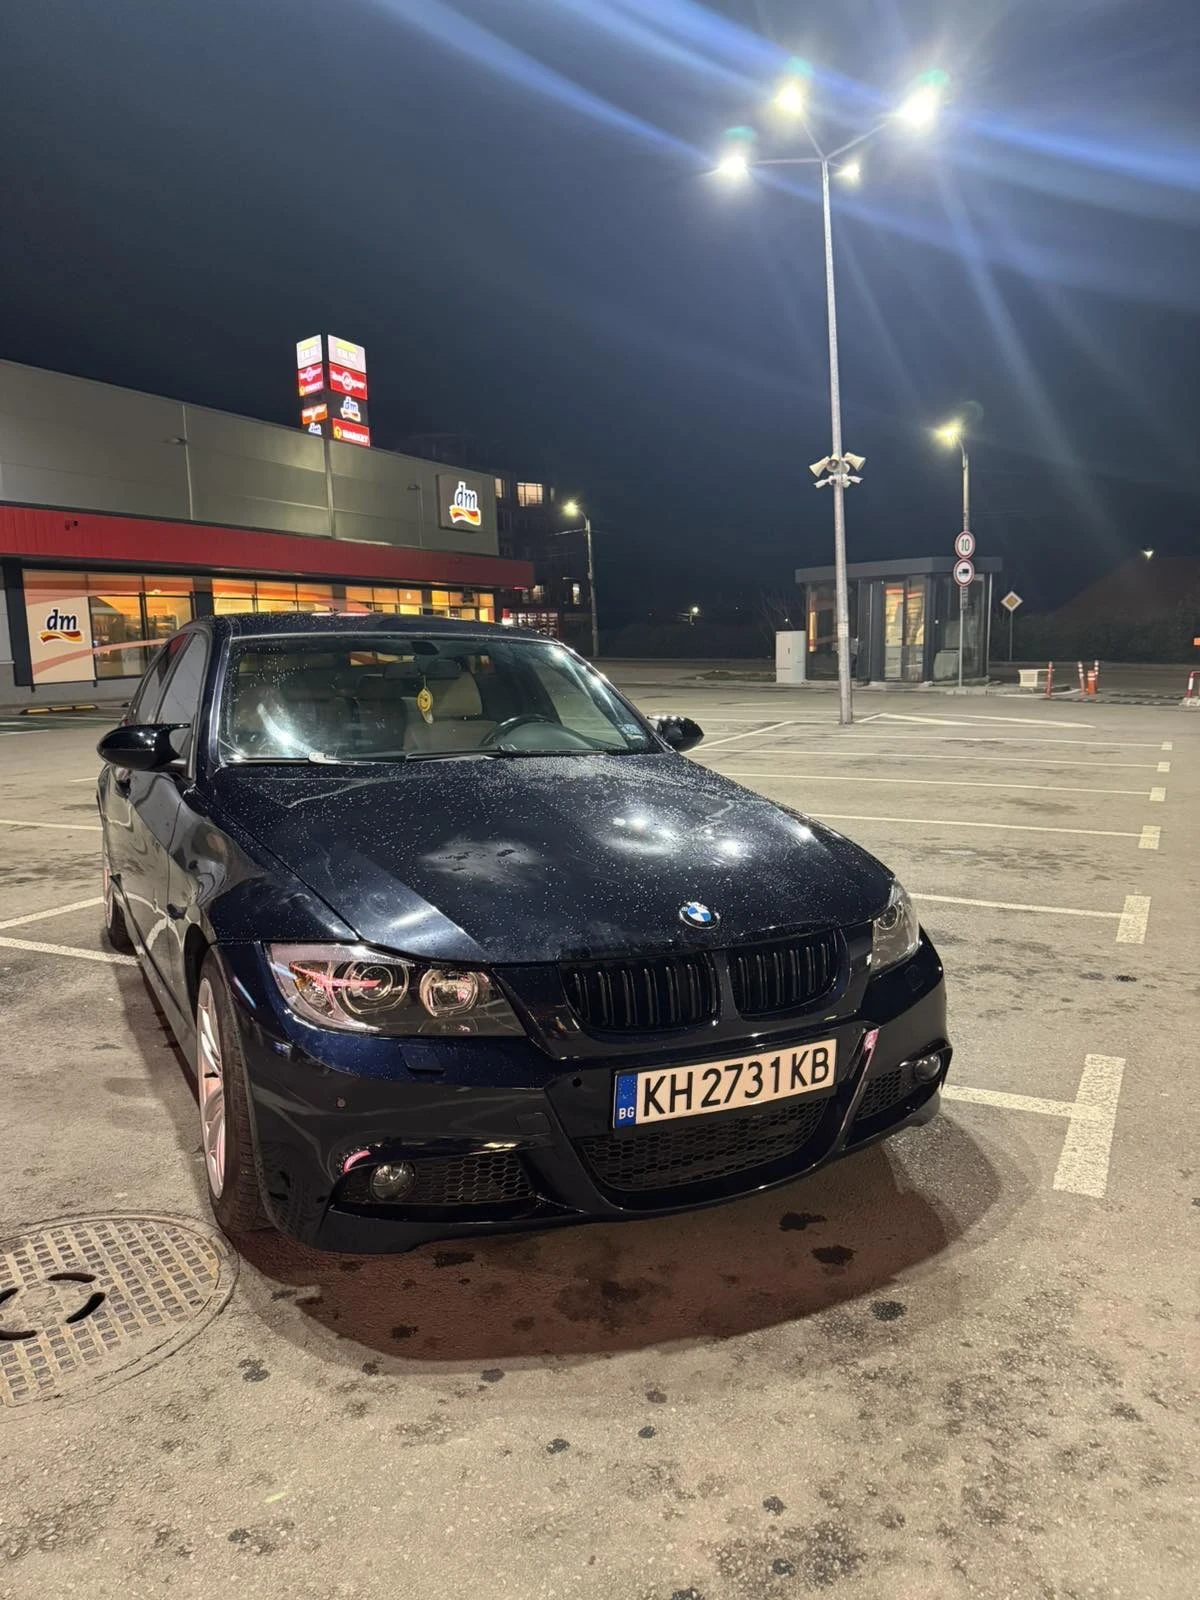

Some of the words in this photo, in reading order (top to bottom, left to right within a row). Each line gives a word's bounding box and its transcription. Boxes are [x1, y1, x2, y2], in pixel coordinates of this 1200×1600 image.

[456, 484, 476, 509] dm
[961, 538, 970, 551] 10
[46, 609, 77, 630] dm
[618, 1107, 635, 1120] BG
